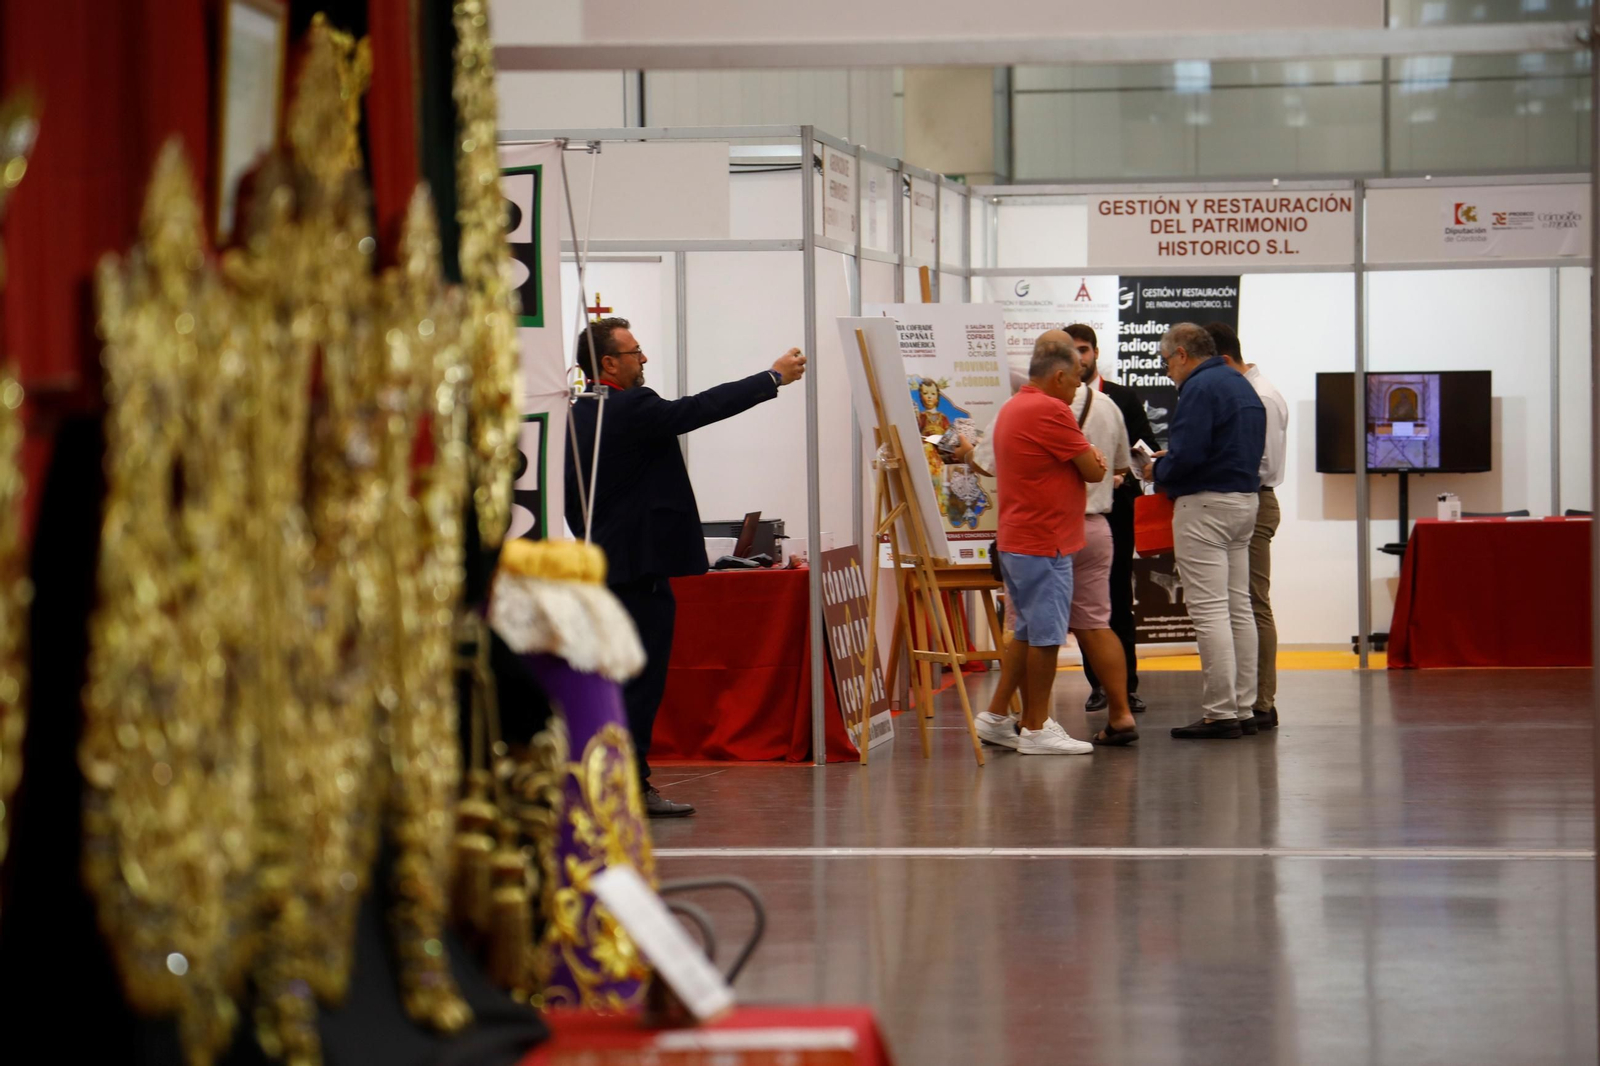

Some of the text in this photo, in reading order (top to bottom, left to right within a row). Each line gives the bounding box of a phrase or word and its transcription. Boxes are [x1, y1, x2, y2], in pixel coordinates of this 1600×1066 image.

[1099, 194, 1352, 215] GESTIÓN Y RESTAURACIÓN
[1150, 217, 1308, 234] DEL PATRIMONIO
[1158, 240, 1300, 256] HISTORICO S.L.
[1142, 286, 1237, 298] GESTIÓN Y RESTAURACIÓN
[1119, 321, 1170, 334] Estudios
[900, 331, 928, 340] ESPAÑA
[1007, 335, 1020, 345] de
[976, 342, 982, 350] 4
[991, 341, 996, 350] 5
[954, 361, 999, 372] PROVINCIA
[962, 376, 1000, 386] CÓRDOBA
[822, 561, 866, 606] CÓRDOBA
